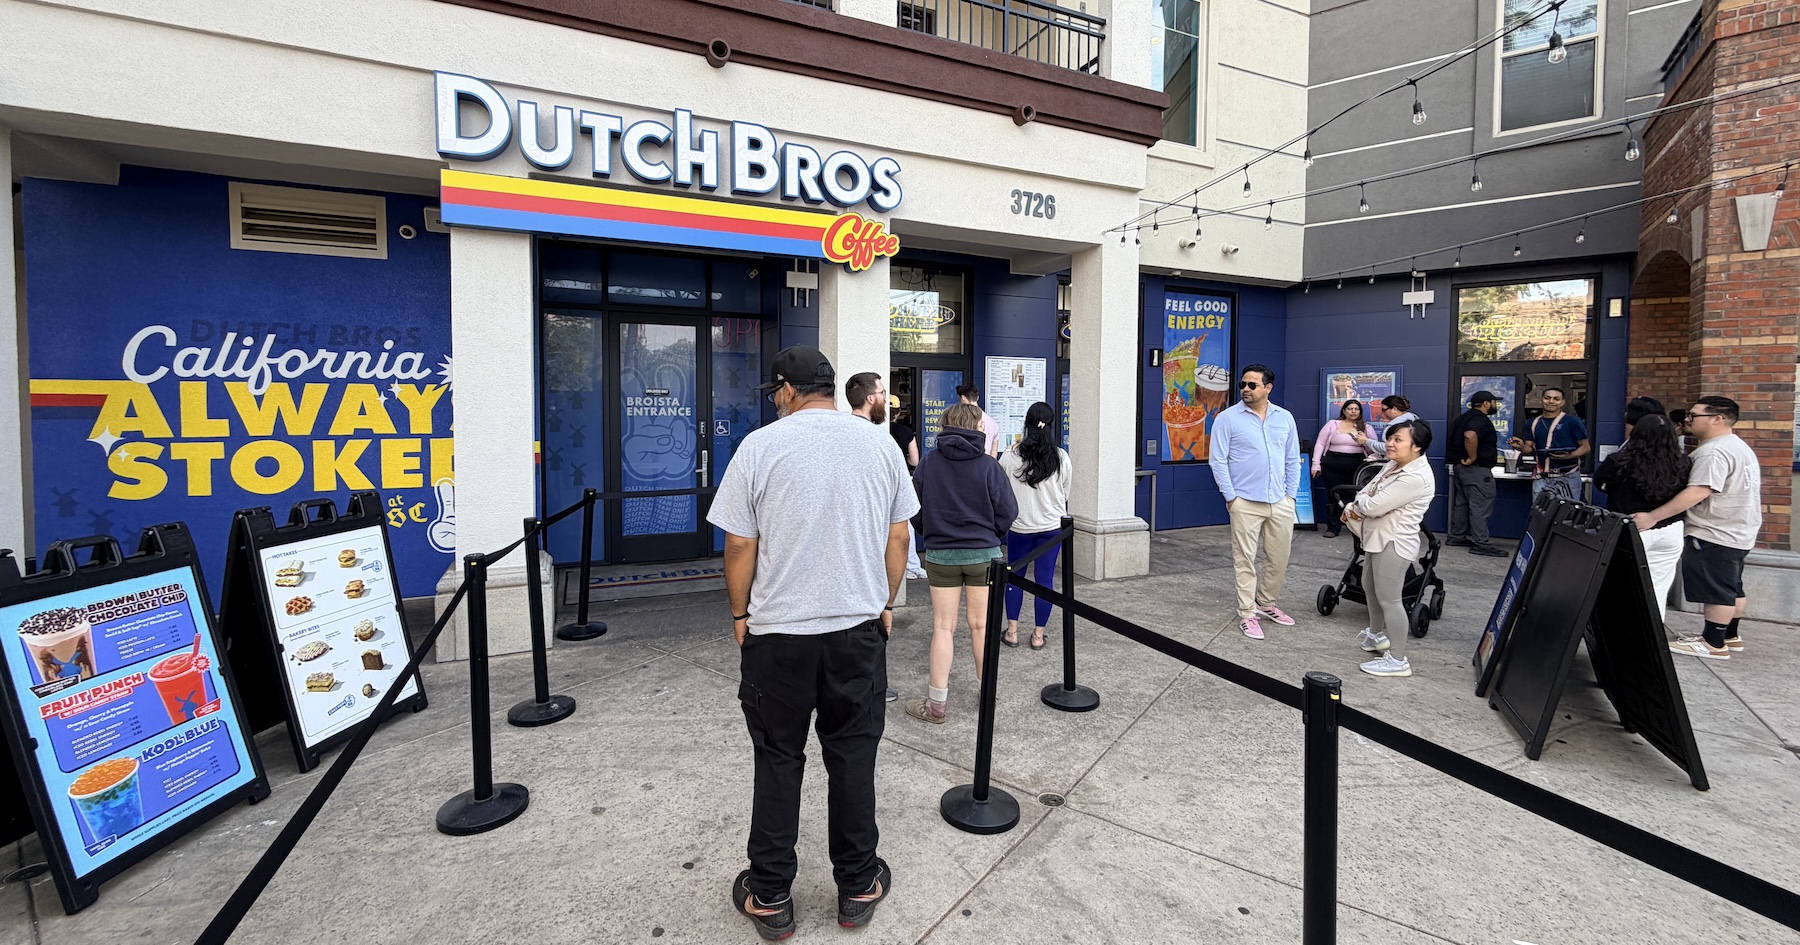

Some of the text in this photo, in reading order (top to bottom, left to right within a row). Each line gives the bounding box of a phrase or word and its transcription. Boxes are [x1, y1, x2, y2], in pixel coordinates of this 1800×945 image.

[434, 70, 903, 213] DUTCH BROS
[1011, 189, 1056, 219] 3726
[823, 213, 899, 269] Coffee
[1165, 298, 1228, 313] FEEL GOOD
[328, 324, 422, 347] BROS
[714, 317, 760, 348] OP
[1168, 314, 1225, 329] ENERGY
[122, 325, 433, 395] California
[90, 380, 453, 438] ALWAY
[626, 397, 680, 407] BROISTA
[626, 407, 691, 417] ENTRANCE
[388, 494, 404, 507] at
[87, 583, 180, 613] BROWN BUTTER
[88, 592, 186, 624] CHOCOLATE CHIP
[289, 628, 308, 638] BAKERY
[40, 692, 89, 716] FRUIT
[92, 673, 142, 698] PUNCH
[141, 719, 218, 761] KOOL BLUE
